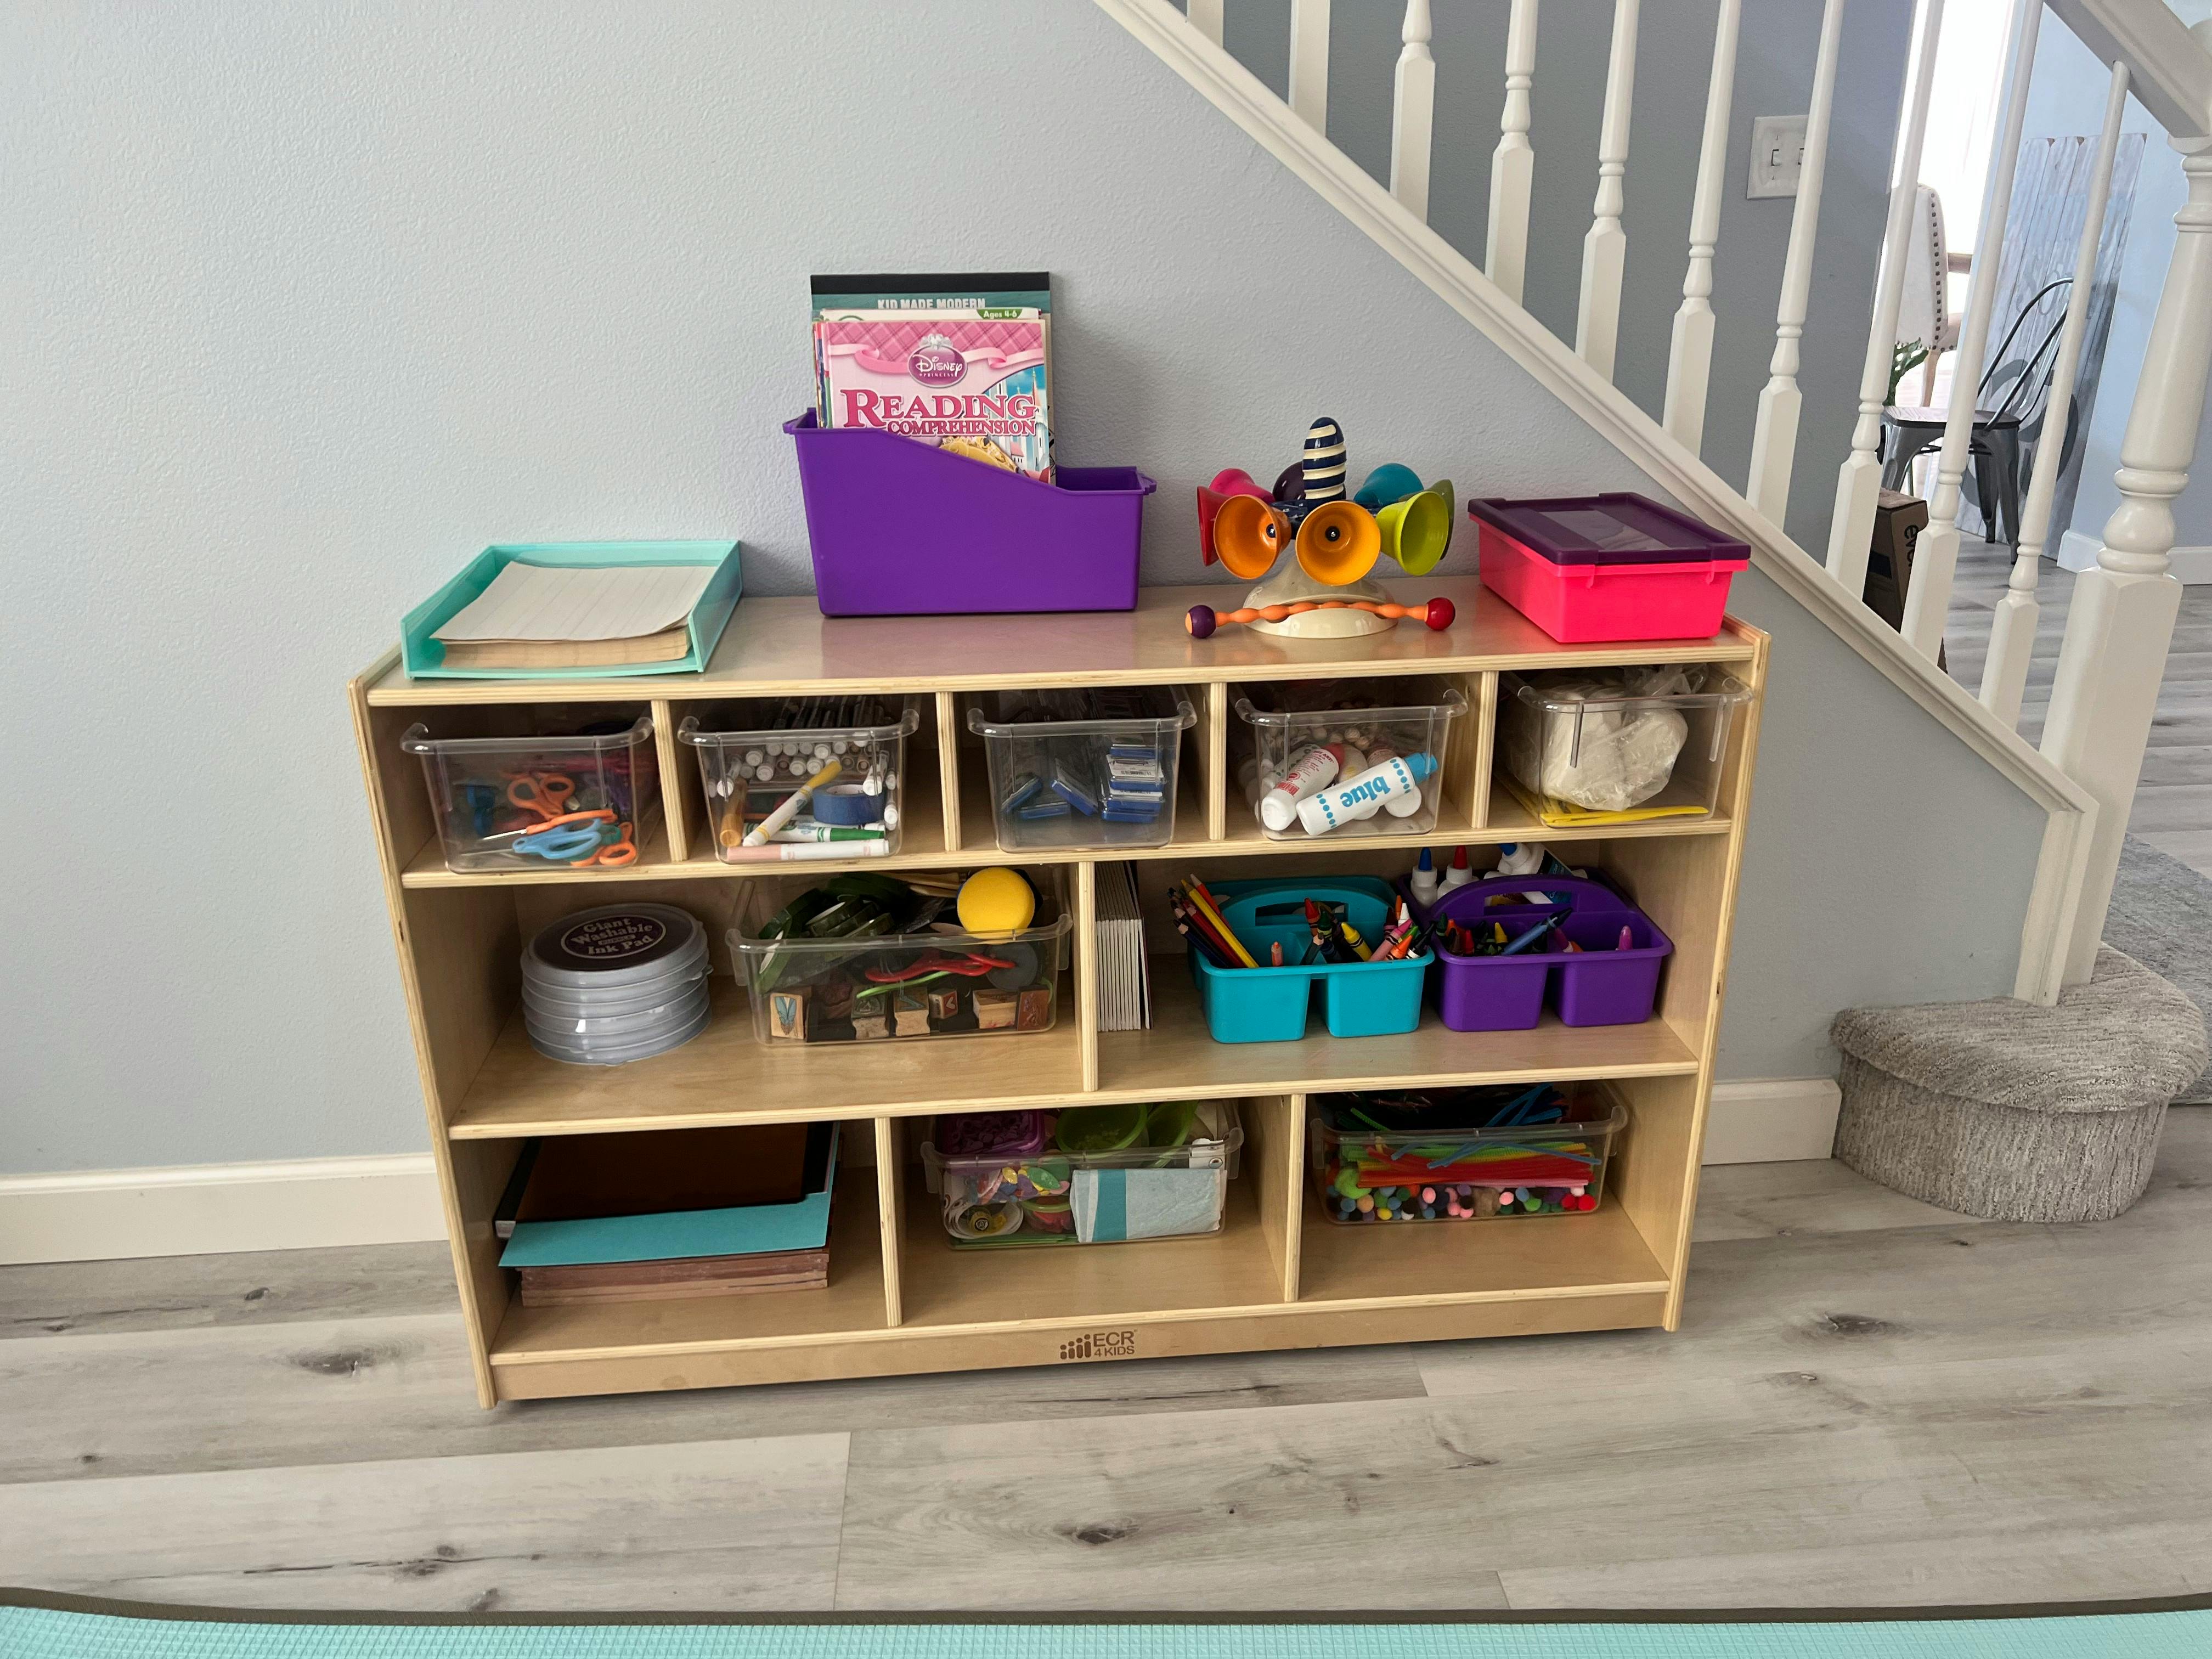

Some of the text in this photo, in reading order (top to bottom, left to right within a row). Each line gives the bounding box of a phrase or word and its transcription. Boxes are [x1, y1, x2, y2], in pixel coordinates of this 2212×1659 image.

[878, 298, 986, 309] KID MADE MODERN
[983, 311, 1002, 319] Ages
[912, 354, 963, 377] Disney
[840, 389, 1036, 428] READING
[887, 420, 1036, 436] COMPREHENSION
[1340, 776, 1391, 807] blue
[584, 918, 631, 932] Giant
[571, 923, 653, 944] Washable
[588, 945, 619, 955] Ink
[622, 935, 653, 949] Pad
[1093, 1331, 1135, 1347] ECR
[1094, 1345, 1135, 1357] 4 KIDS
